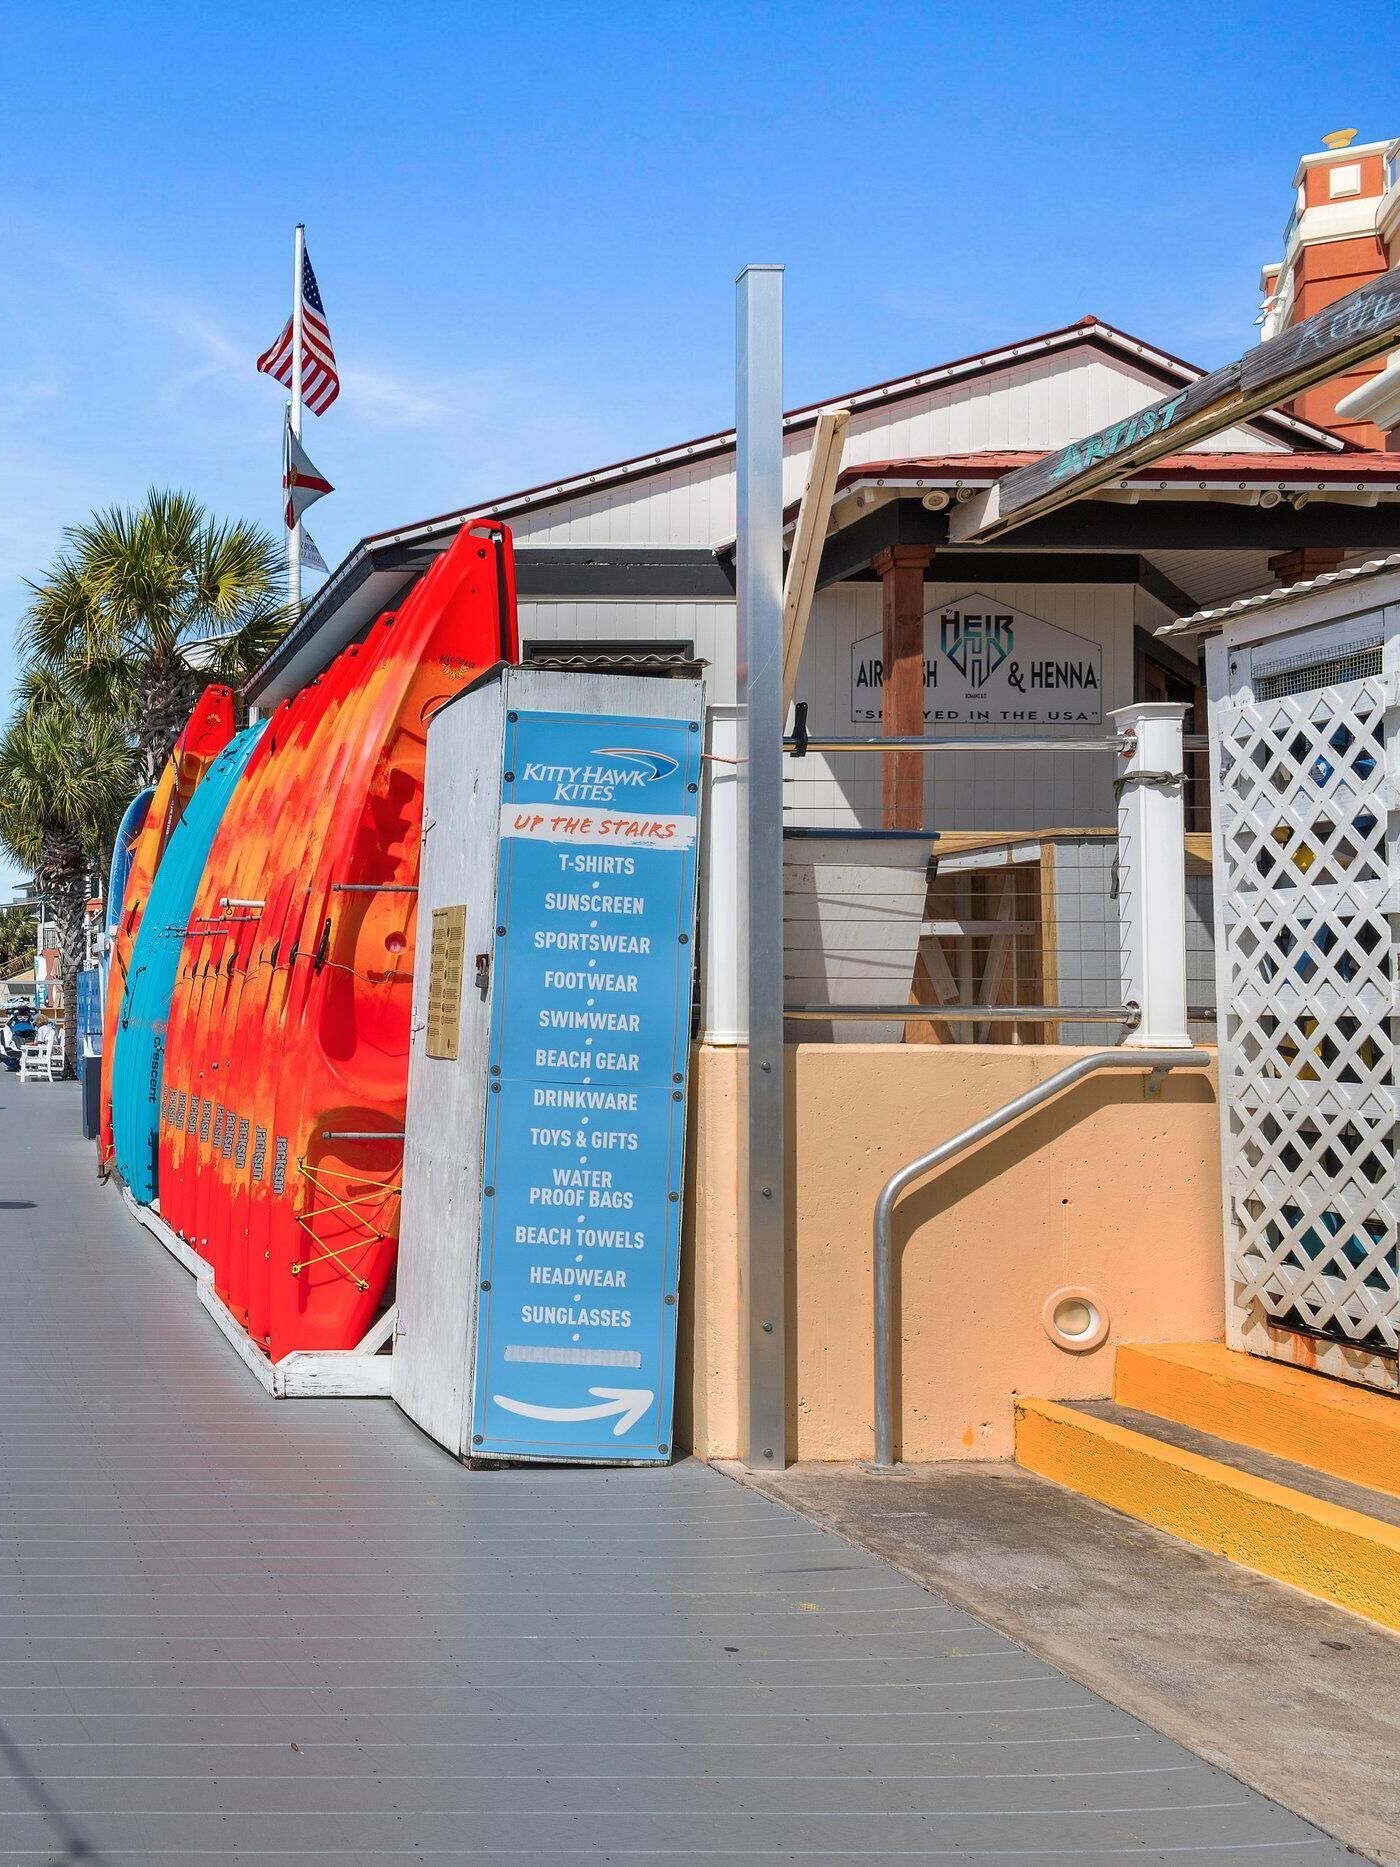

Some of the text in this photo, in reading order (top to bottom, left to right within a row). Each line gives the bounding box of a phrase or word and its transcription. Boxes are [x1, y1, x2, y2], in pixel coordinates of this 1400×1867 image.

[1050, 389, 1189, 479] ARTIST
[1008, 661, 1027, 693] &
[1031, 661, 1098, 689] HENNA
[970, 710, 990, 720] IN
[1000, 711, 1038, 721] THE
[1047, 711, 1098, 721] USA"
[523, 763, 649, 787] KITTY HAWK
[553, 783, 615, 801] KITES
[514, 814, 676, 839] UP THE STAIRS
[559, 854, 635, 875] T-SHIRTS
[545, 892, 644, 915] SUNSCREEN
[534, 931, 651, 954] SPORTSWEAR
[544, 970, 638, 993] FOOTWEAR
[539, 1009, 640, 1032] SWIMWEAR
[535, 1048, 639, 1072] BEACH GEAR
[533, 1088, 638, 1111] DRINKWARE
[221, 1110, 236, 1159] Jackson
[235, 1116, 250, 1169] Jackson
[530, 1127, 638, 1150] TOYS & GIFTS
[252, 1125, 267, 1181] Jackson
[272, 1135, 287, 1194] Jackson
[552, 1168, 612, 1189] WATER
[529, 1187, 633, 1209] PROOF BAGS
[515, 1226, 645, 1249] BEACH TOWELS
[530, 1266, 627, 1288] HEADWEAR
[521, 1305, 632, 1328] SUNGLASSES
